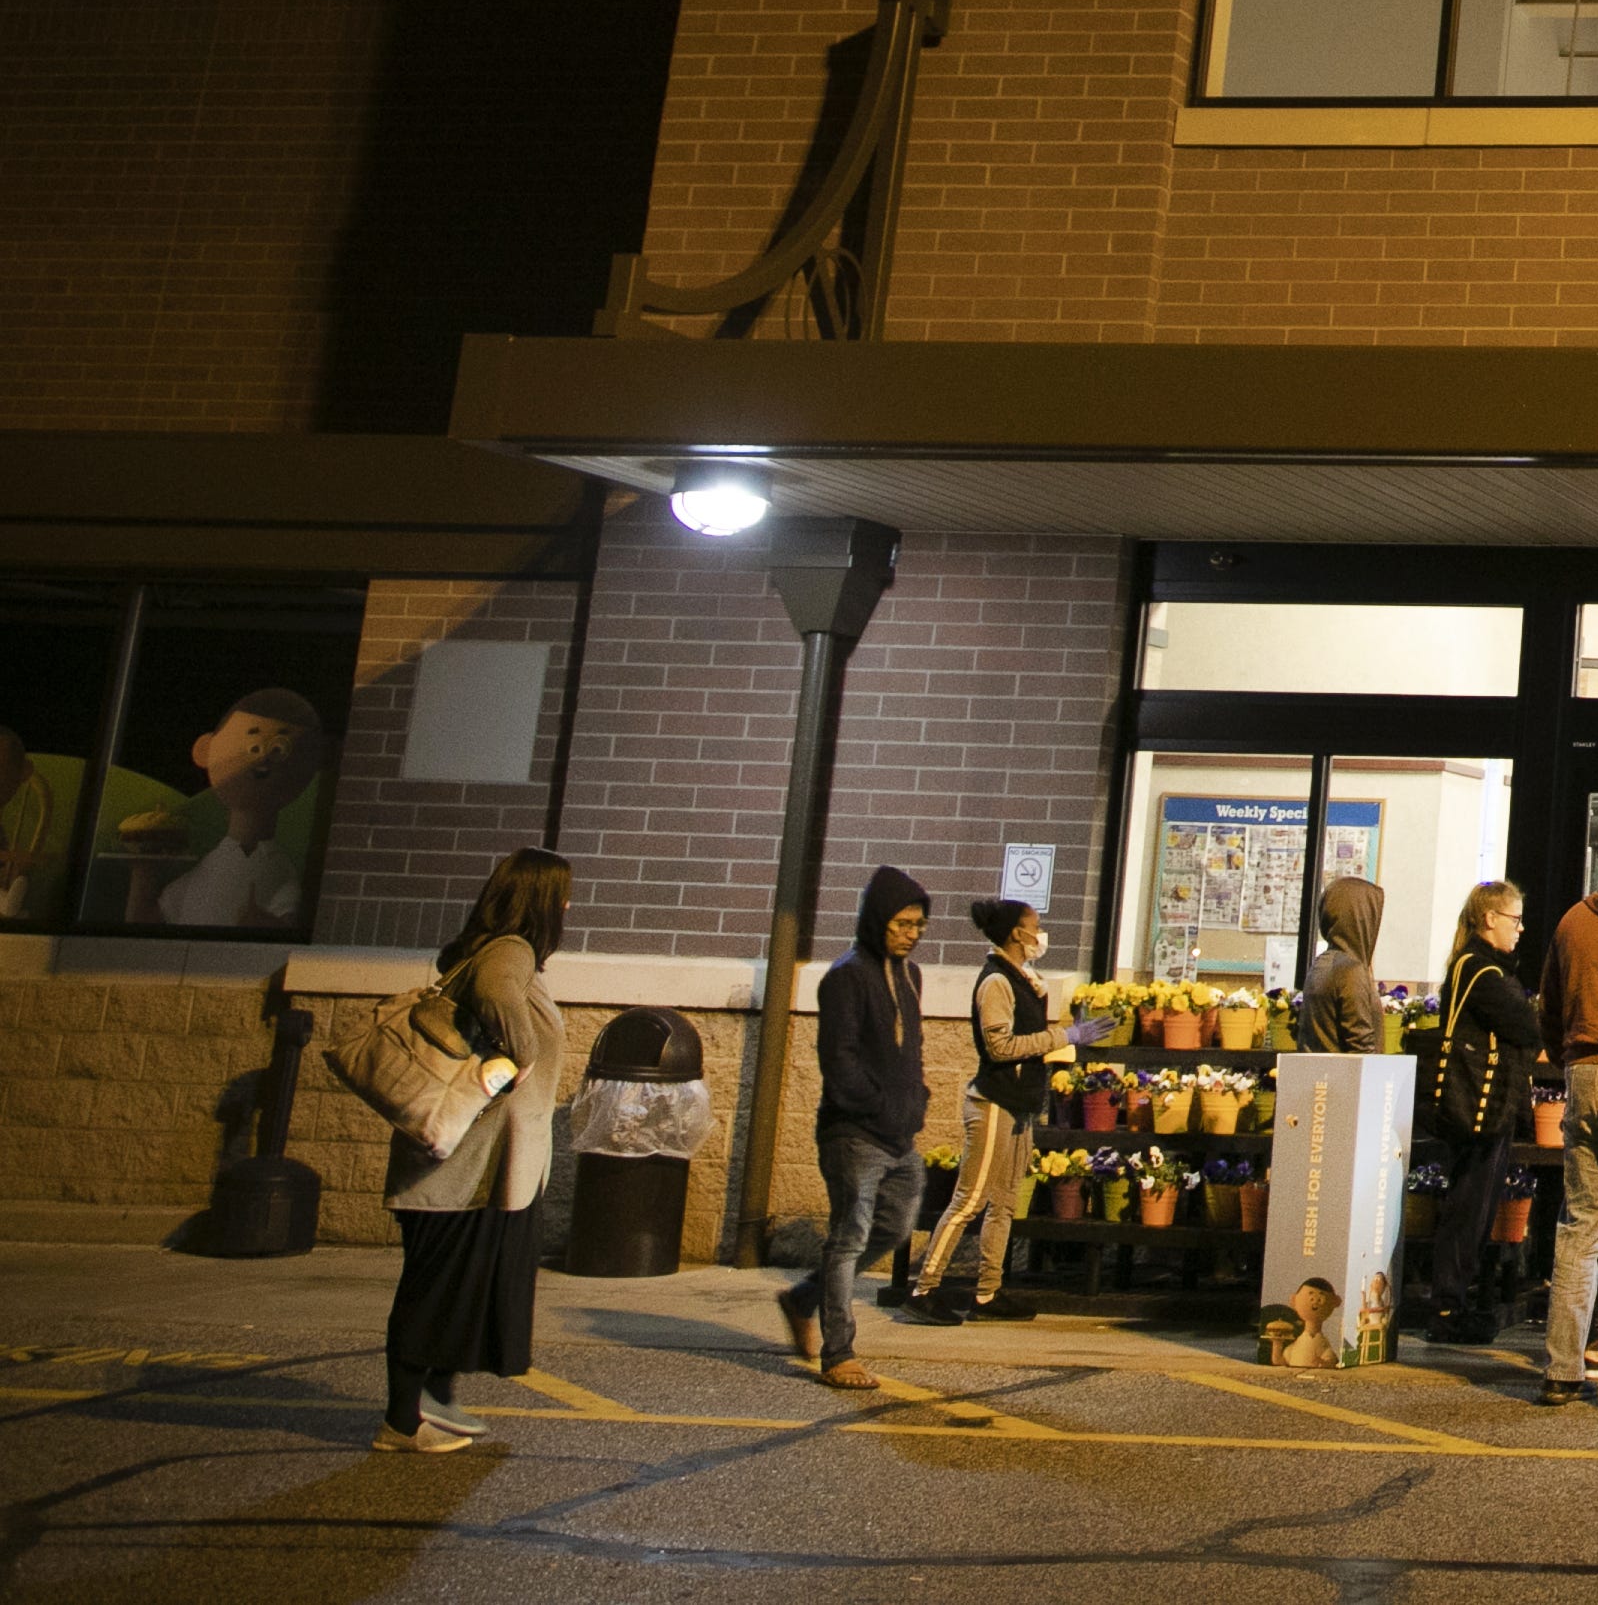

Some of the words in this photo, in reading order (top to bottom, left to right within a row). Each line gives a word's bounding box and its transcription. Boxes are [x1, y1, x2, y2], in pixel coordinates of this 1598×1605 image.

[1216, 804, 1267, 821] Weekly
[1307, 1168, 1322, 1202] FOR
[1378, 1167, 1389, 1200] FOR
[1303, 1206, 1319, 1257] FRESH
[1374, 1205, 1386, 1255] FRESH
